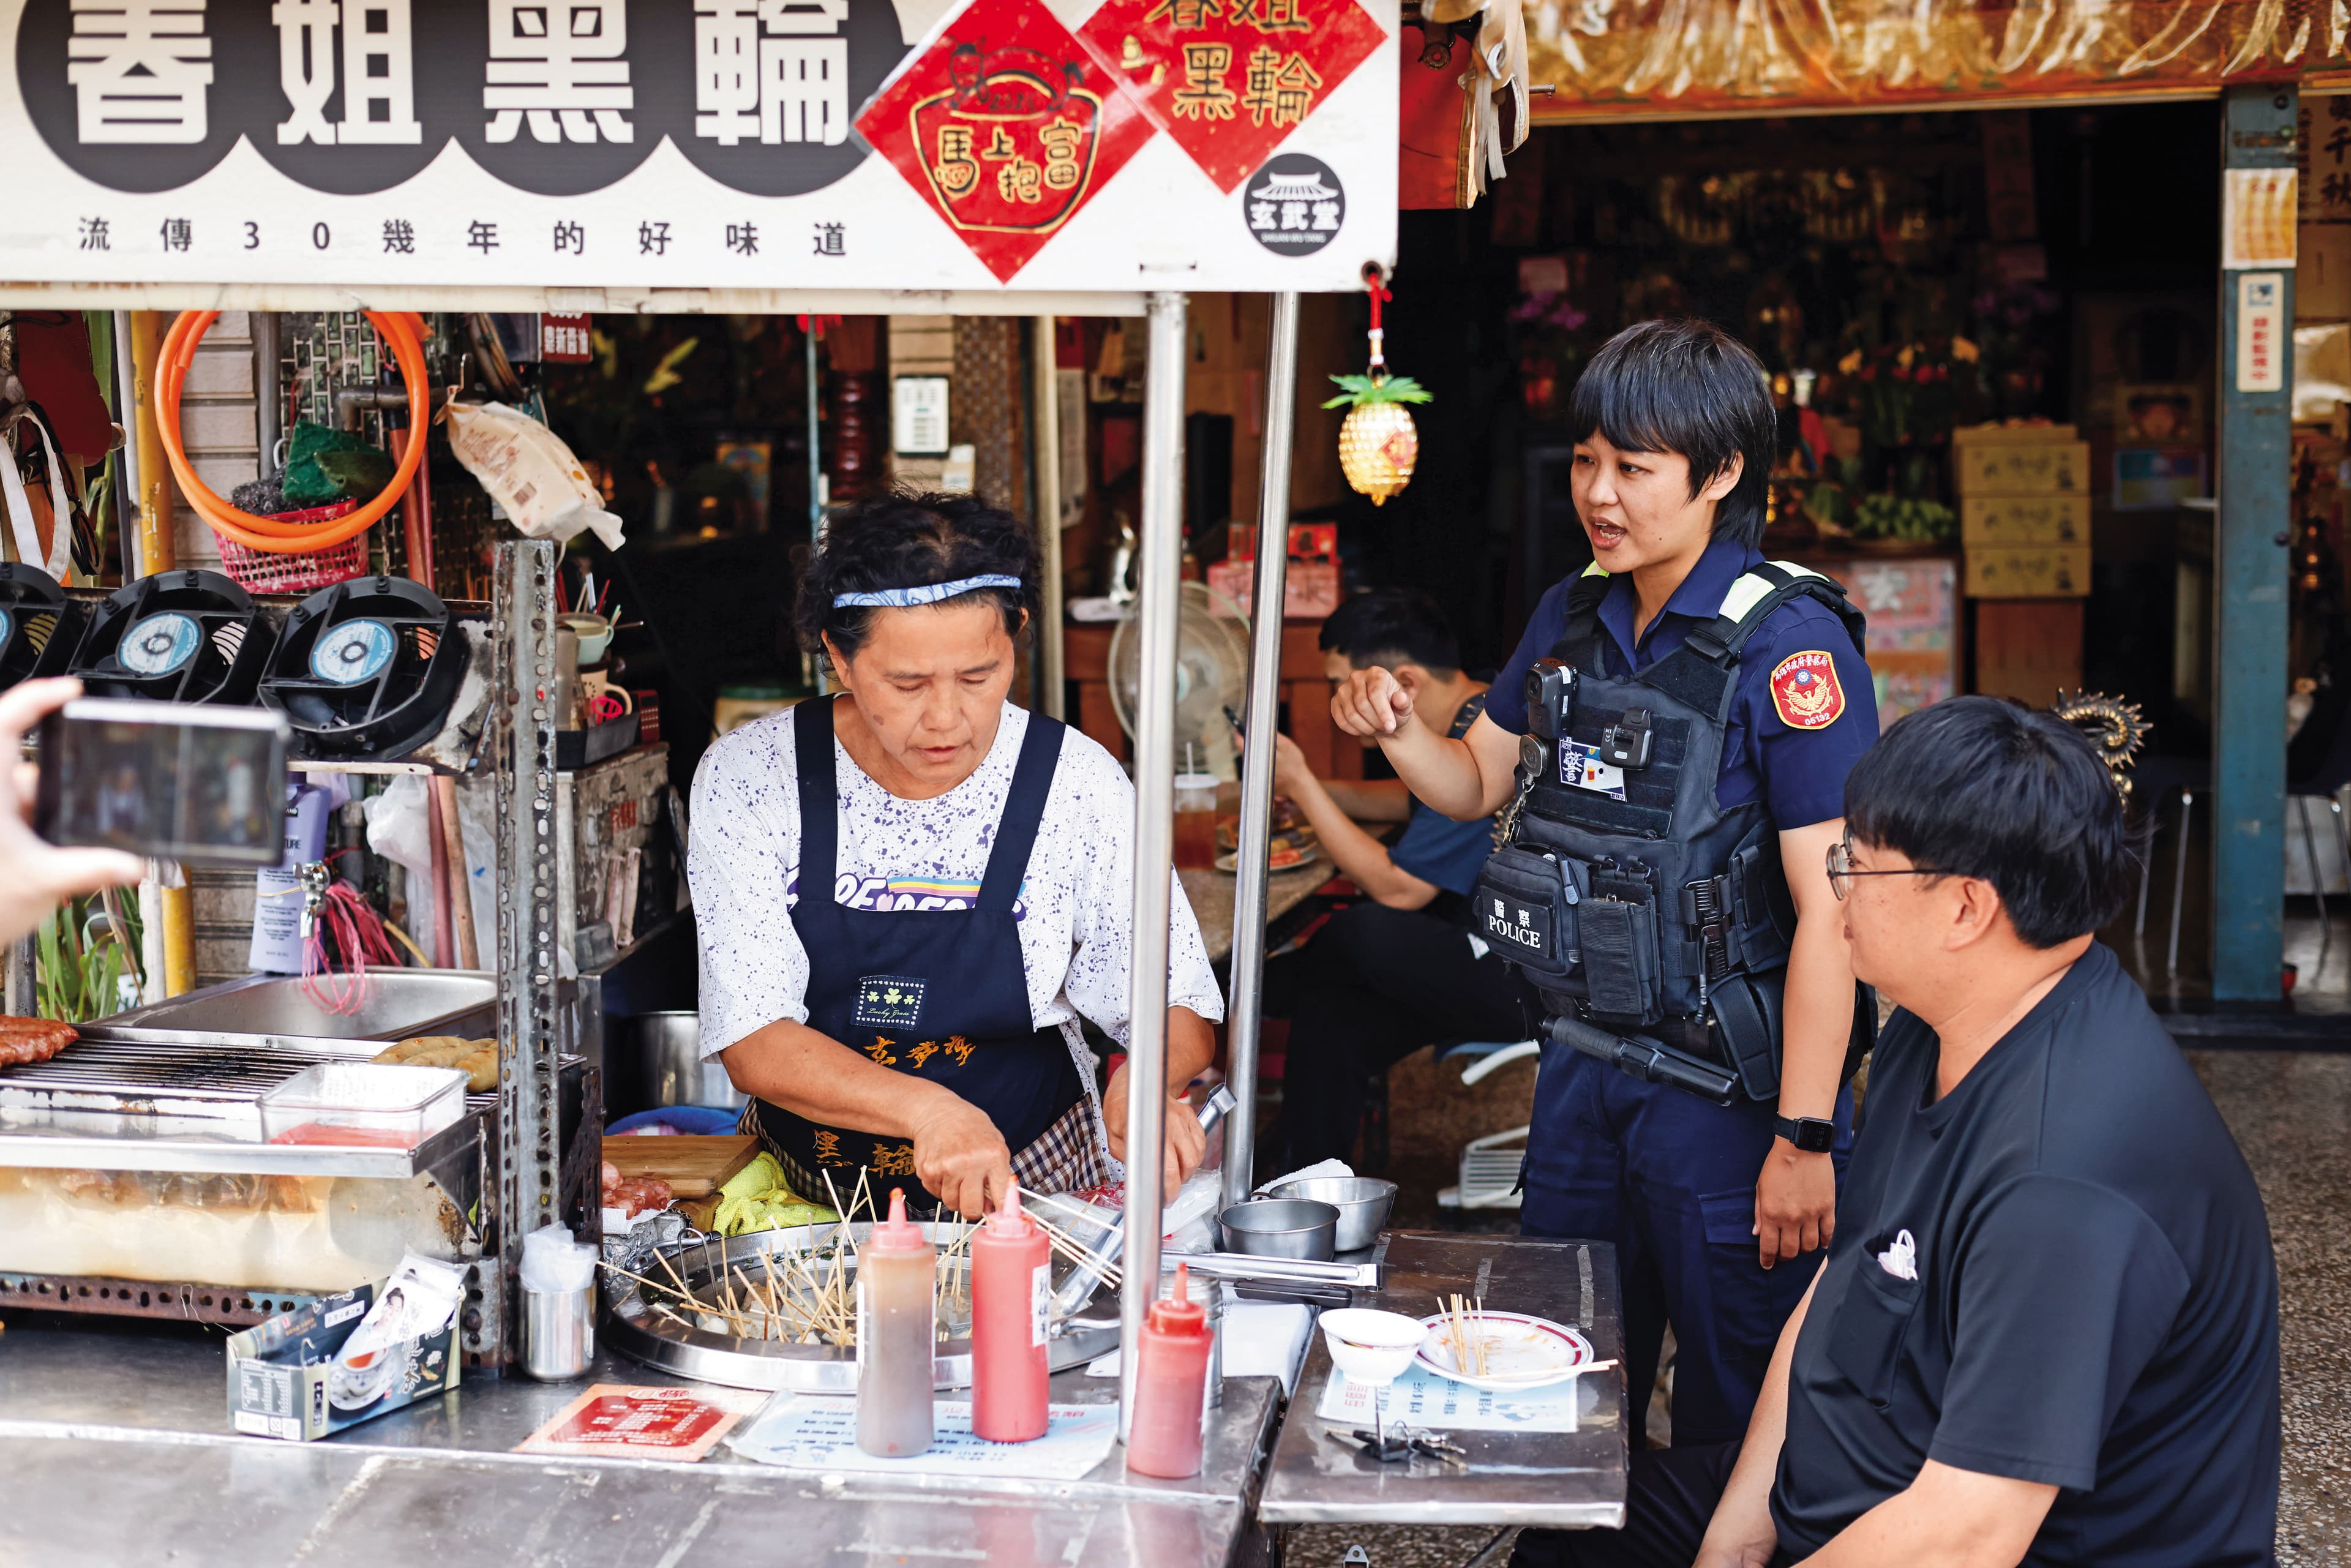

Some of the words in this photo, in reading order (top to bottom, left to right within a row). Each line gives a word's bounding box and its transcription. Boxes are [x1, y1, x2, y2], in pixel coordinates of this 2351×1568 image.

[67, 0, 849, 146] 春姐黑輪
[1172, 42, 1324, 129] 黑輪
[1250, 200, 1340, 231] 玄武堂
[78, 217, 847, 257] 流傳30幾年的好味道
[1774, 654, 1828, 681] 高雄市政府警察局
[1804, 712, 1831, 726] 05132
[1494, 898, 1530, 928] 警察
[1488, 914, 1540, 948] POLICE
[866, 1007, 890, 1019] Lucky
